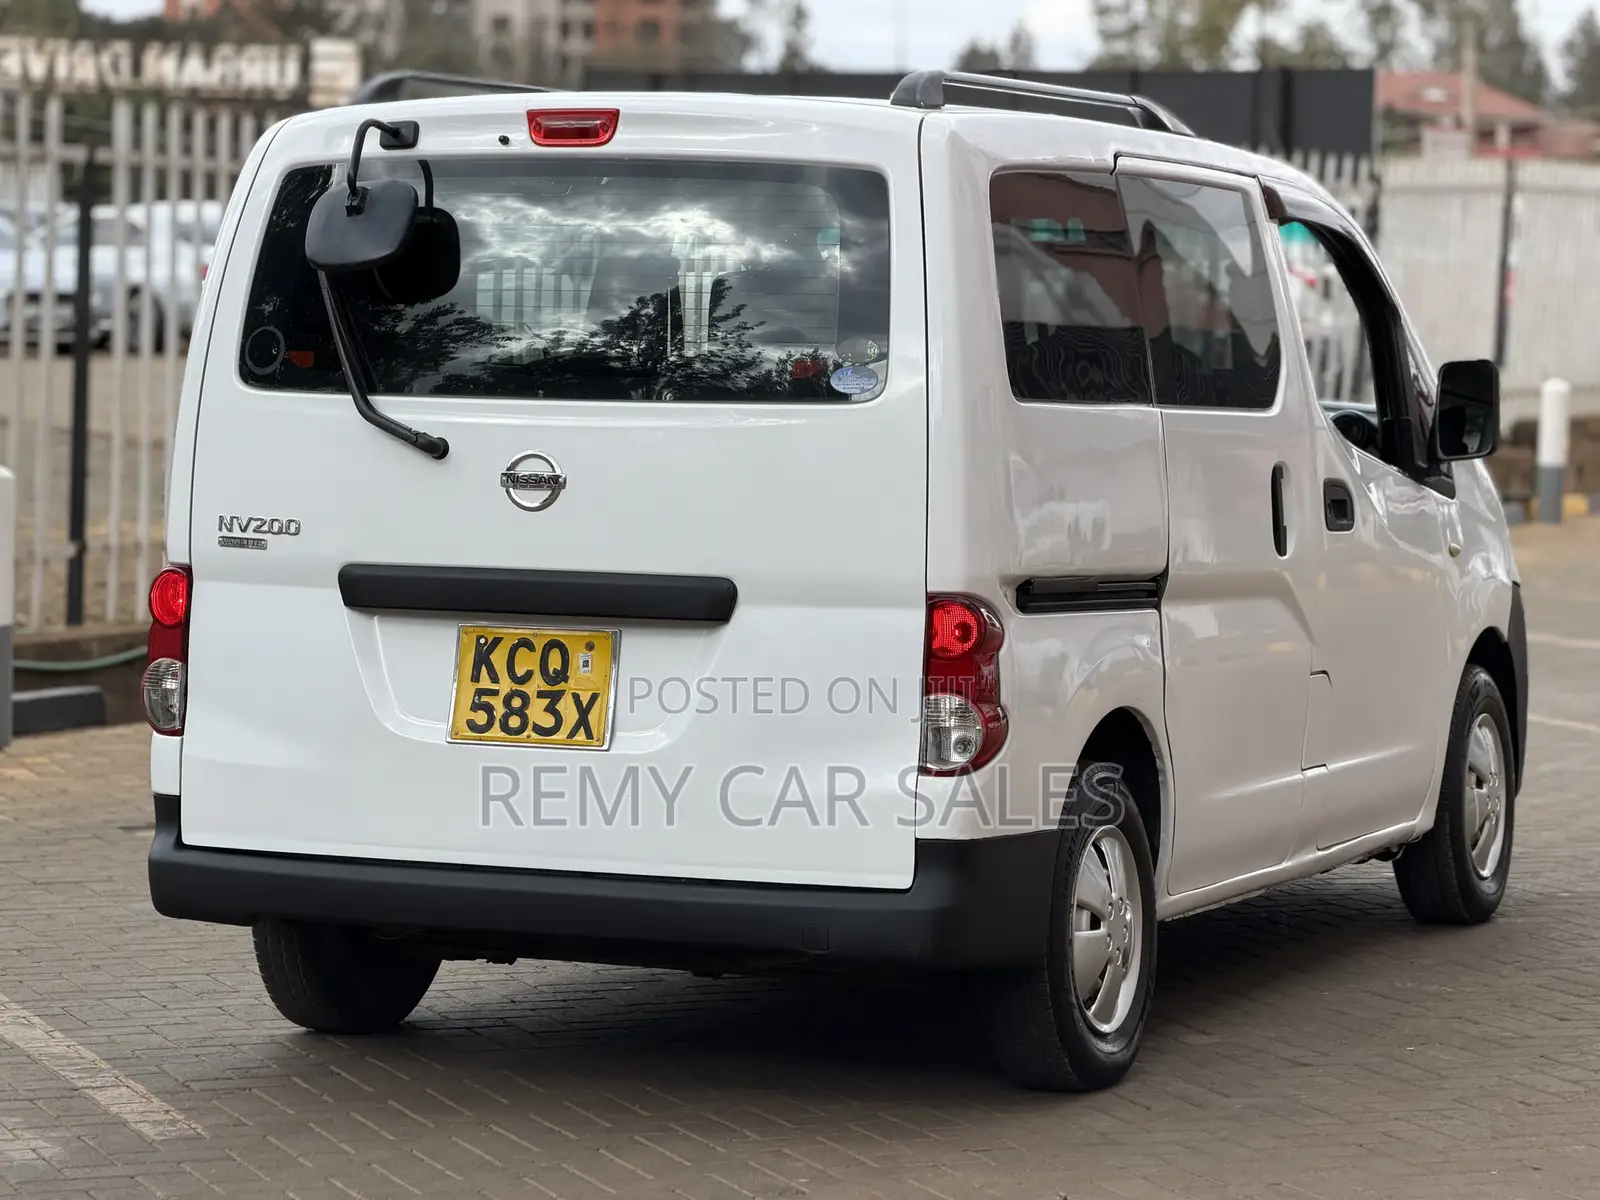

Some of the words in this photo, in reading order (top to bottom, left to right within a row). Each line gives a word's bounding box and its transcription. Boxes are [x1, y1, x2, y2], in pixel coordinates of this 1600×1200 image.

[505, 473, 560, 486] NISSAN
[217, 514, 301, 536] NV200
[470, 634, 570, 686] KCQ
[465, 687, 600, 740] 583X
